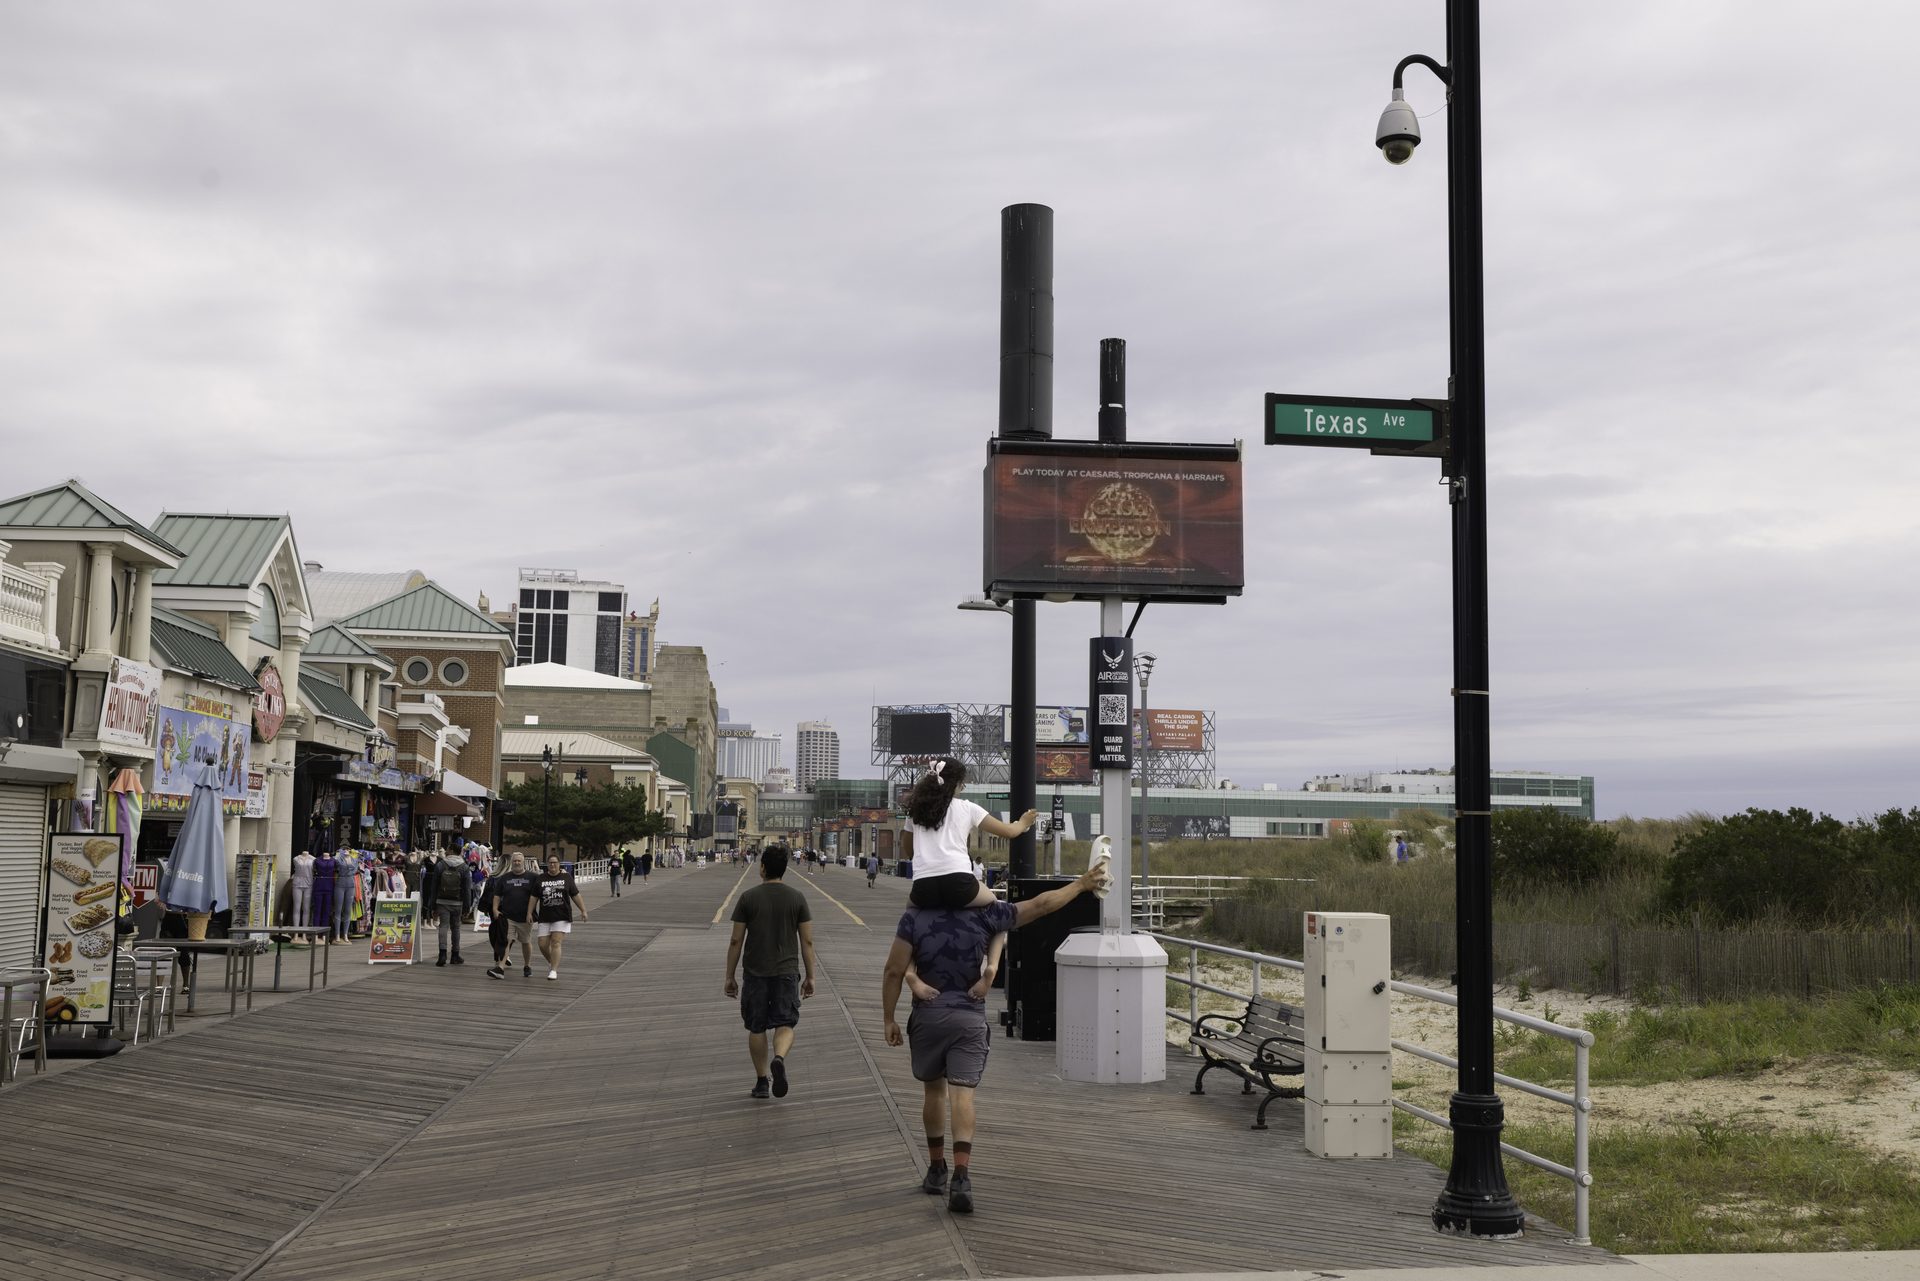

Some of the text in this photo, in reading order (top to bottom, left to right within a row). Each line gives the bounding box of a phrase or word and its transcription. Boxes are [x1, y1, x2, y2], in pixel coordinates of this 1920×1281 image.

[1304, 408, 1405, 435] Texas Ave
[1012, 467, 1034, 476] PLAY
[1036, 468, 1065, 477] TODAY
[1080, 470, 1121, 479] CAESARS,
[1123, 471, 1173, 480] TROPICANA
[1182, 473, 1225, 482] HARRAH'S
[1098, 671, 1112, 681] AIR
[105, 686, 149, 735] HENNA TATTOOS
[733, 730, 753, 738] ROCK
[1103, 736, 1123, 744] GUARD
[193, 745, 202, 763] AC
[1105, 745, 1122, 753] WHAT
[135, 868, 155, 887] TM
[541, 879, 565, 888] BROWNS
